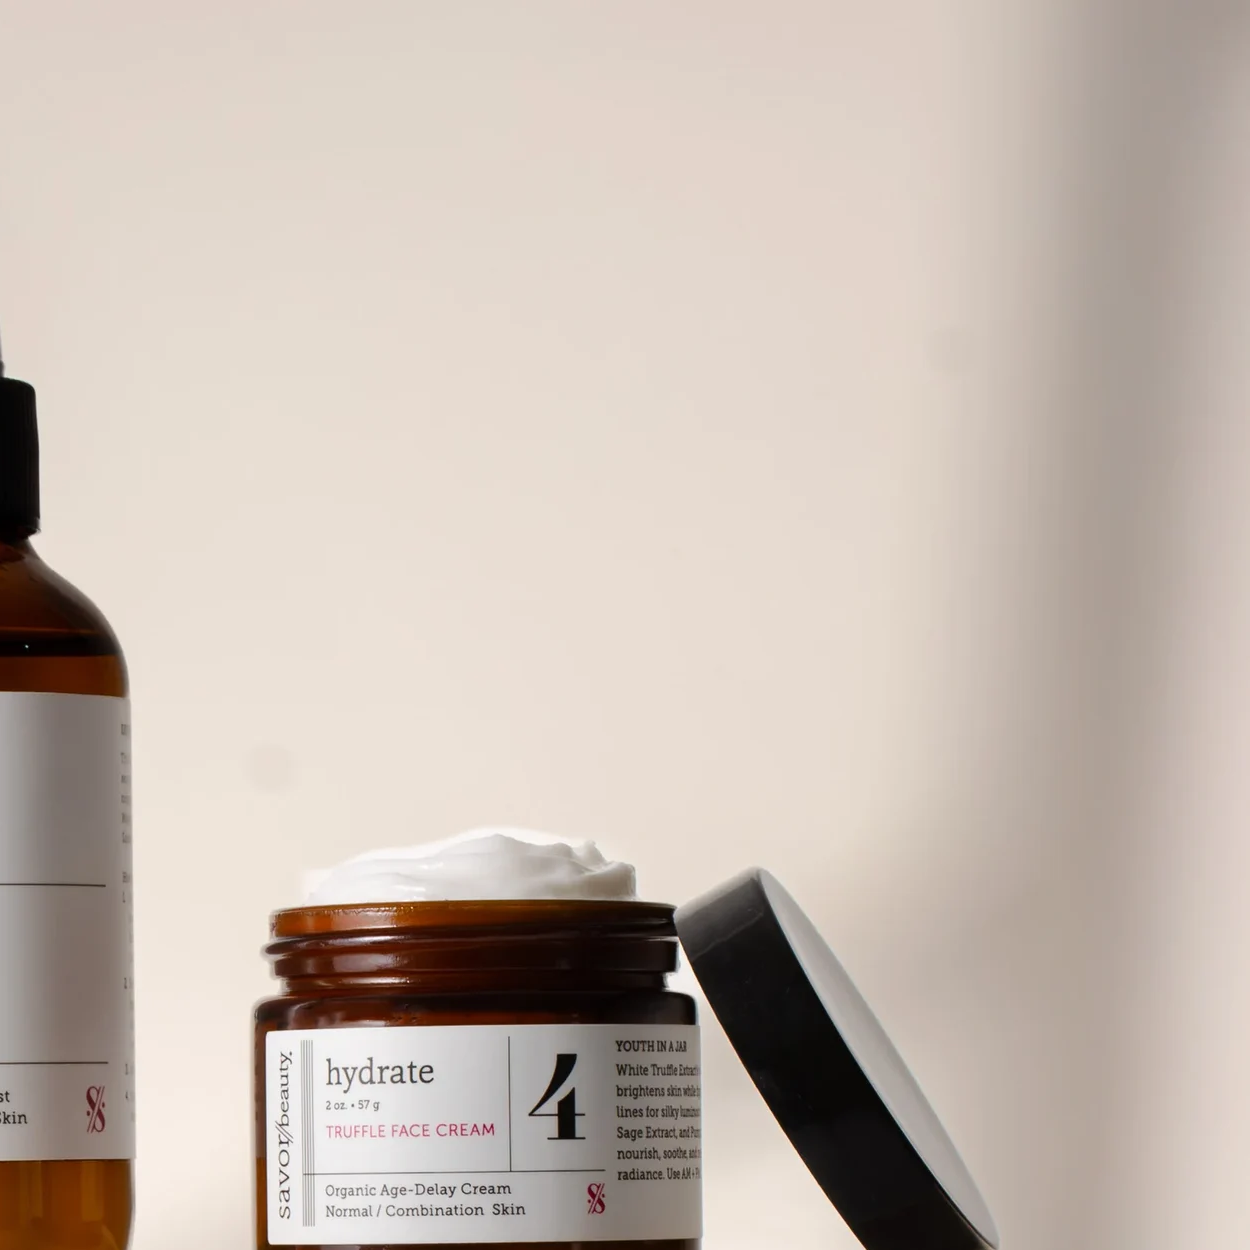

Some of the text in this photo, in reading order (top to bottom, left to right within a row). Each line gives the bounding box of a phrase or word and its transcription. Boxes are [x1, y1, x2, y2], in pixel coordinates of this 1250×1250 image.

[616, 1040, 687, 1052] YOUTH IN A JAR
[325, 1056, 435, 1091] hydrate
[616, 1064, 648, 1076] White
[652, 1064, 677, 1076] Truffle
[528, 1054, 586, 1140] 4
[616, 1085, 664, 1099] brightens
[667, 1086, 682, 1096] skin
[326, 1101, 331, 1110] 2
[358, 1100, 370, 1110] 57
[373, 1102, 380, 1112] g
[616, 1106, 643, 1118] lines
[646, 1106, 658, 1118] for
[661, 1106, 679, 1120] silky
[326, 1123, 495, 1139] TRUFFLE FACE CREAM
[617, 1127, 642, 1141] Sage
[646, 1127, 677, 1140] Extract,
[617, 1148, 661, 1160] nourish,
[663, 1148, 688, 1160] soothe,
[618, 1168, 664, 1180] radiance.
[667, 1168, 680, 1180] Use
[325, 1182, 512, 1199] Organic Age-Delay Cream
[326, 1203, 526, 1218] Normal / Combination Skin
